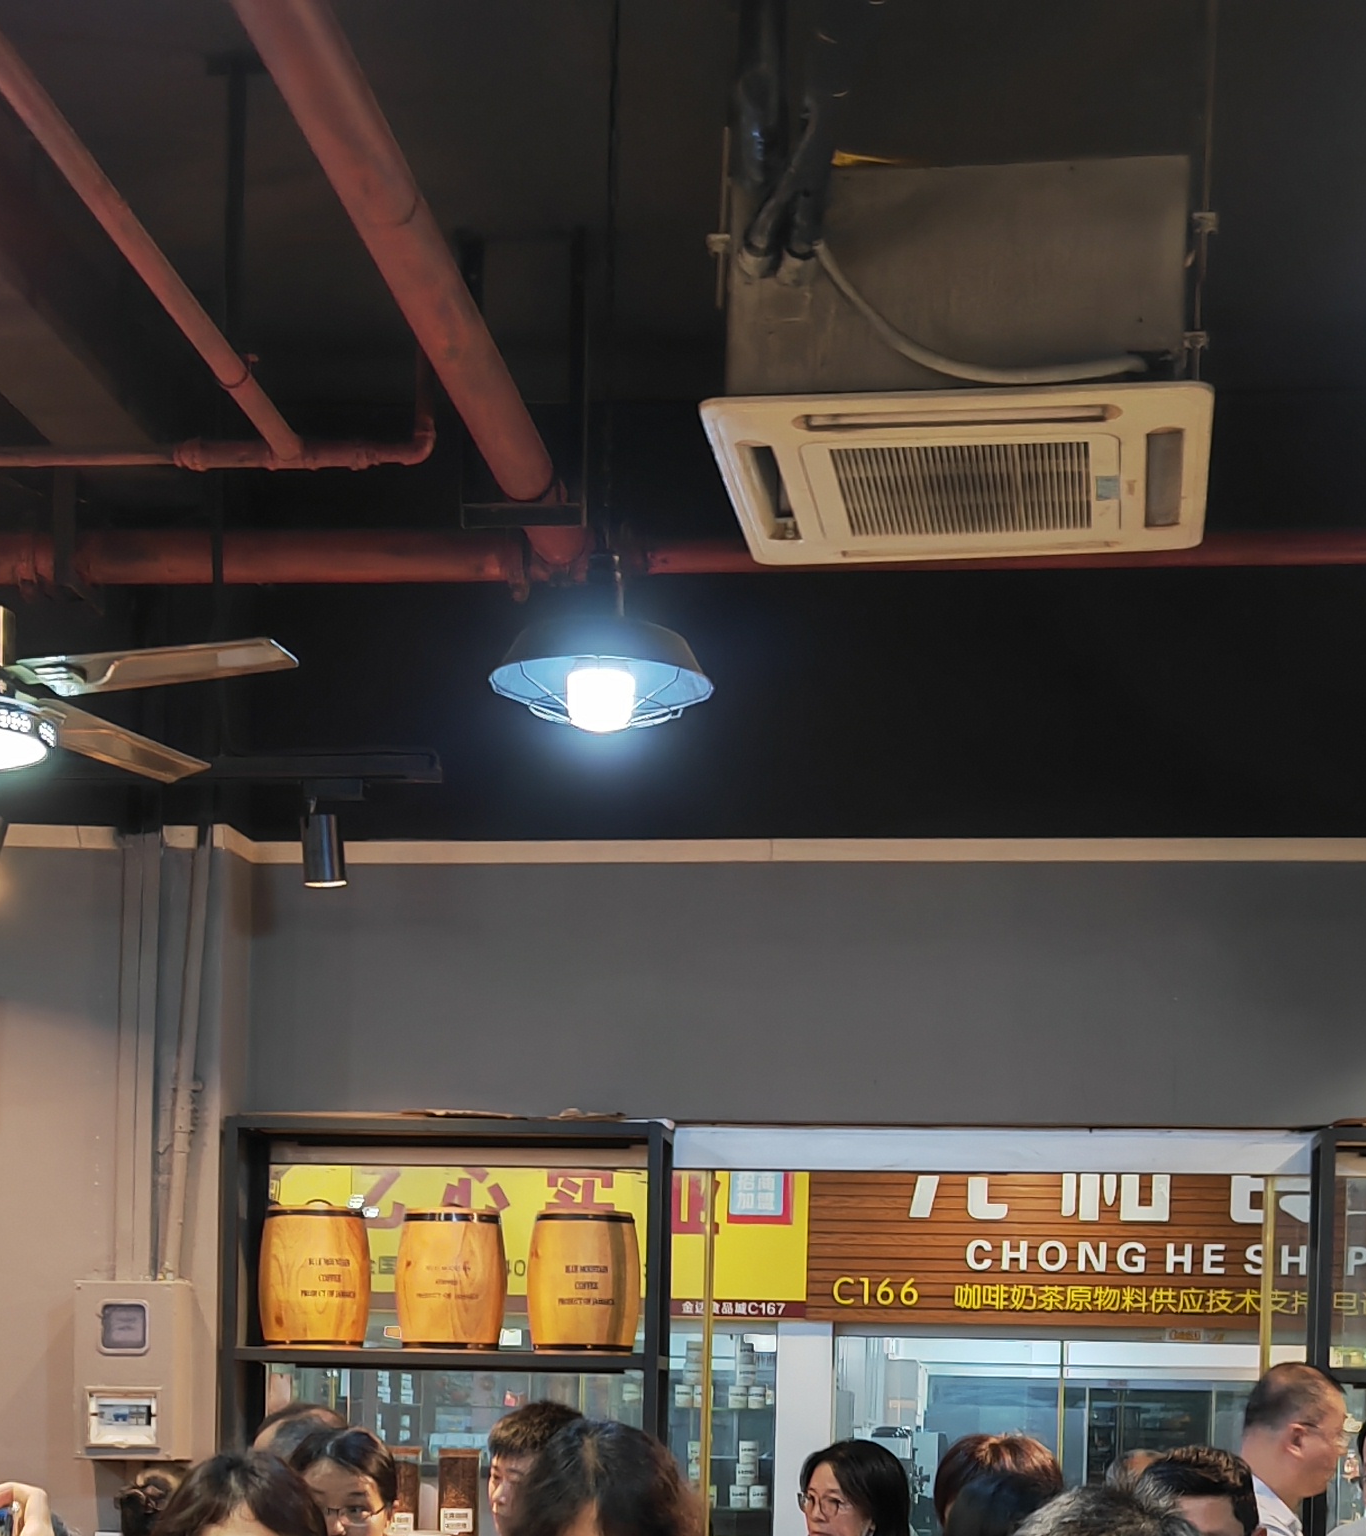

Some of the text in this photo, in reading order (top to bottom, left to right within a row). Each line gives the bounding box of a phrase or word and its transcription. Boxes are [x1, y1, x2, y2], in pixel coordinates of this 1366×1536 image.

[737, 1191, 775, 1211] 加盟
[965, 1239, 1147, 1274] CHONG
[1166, 1243, 1226, 1275] HE
[1243, 1244, 1308, 1276] SH
[832, 1276, 920, 1306] C166
